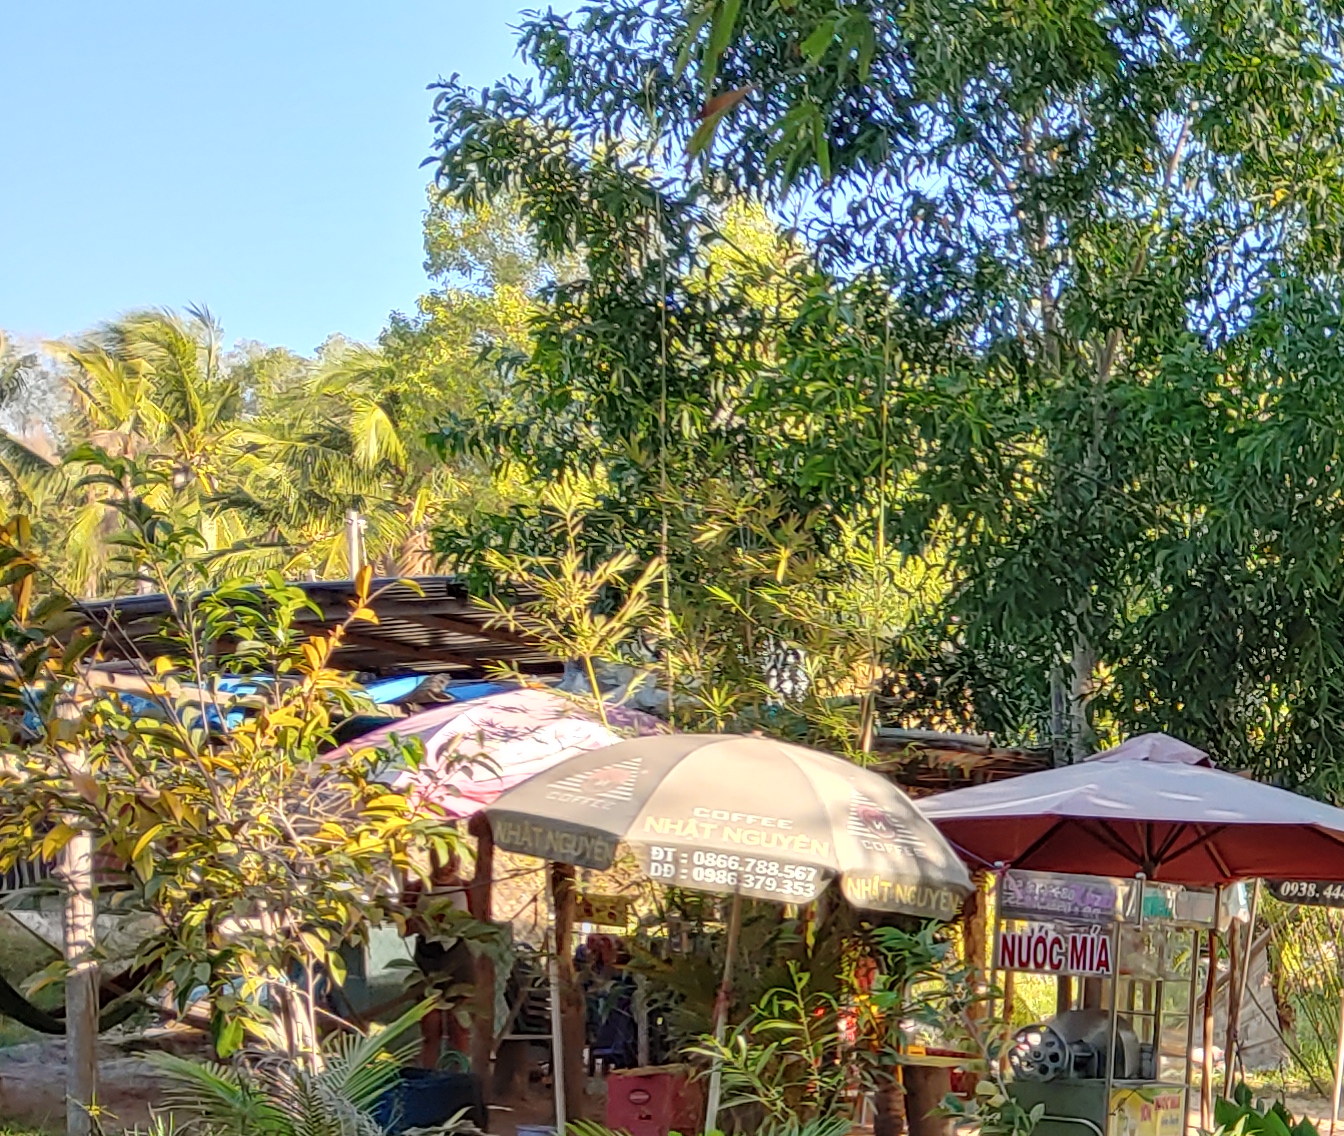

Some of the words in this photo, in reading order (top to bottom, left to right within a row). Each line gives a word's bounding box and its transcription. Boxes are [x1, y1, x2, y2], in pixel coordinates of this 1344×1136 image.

[643, 816, 718, 842] NHẬT
[693, 807, 794, 830] COFFEE
[651, 846, 677, 863] ĐT
[693, 851, 818, 882] 0866.788.567
[692, 867, 816, 898] 0986.379.353
[1280, 881, 1320, 898] 0938.
[1001, 928, 1065, 970] NƯỚC
[1069, 926, 1111, 973] MÍA
